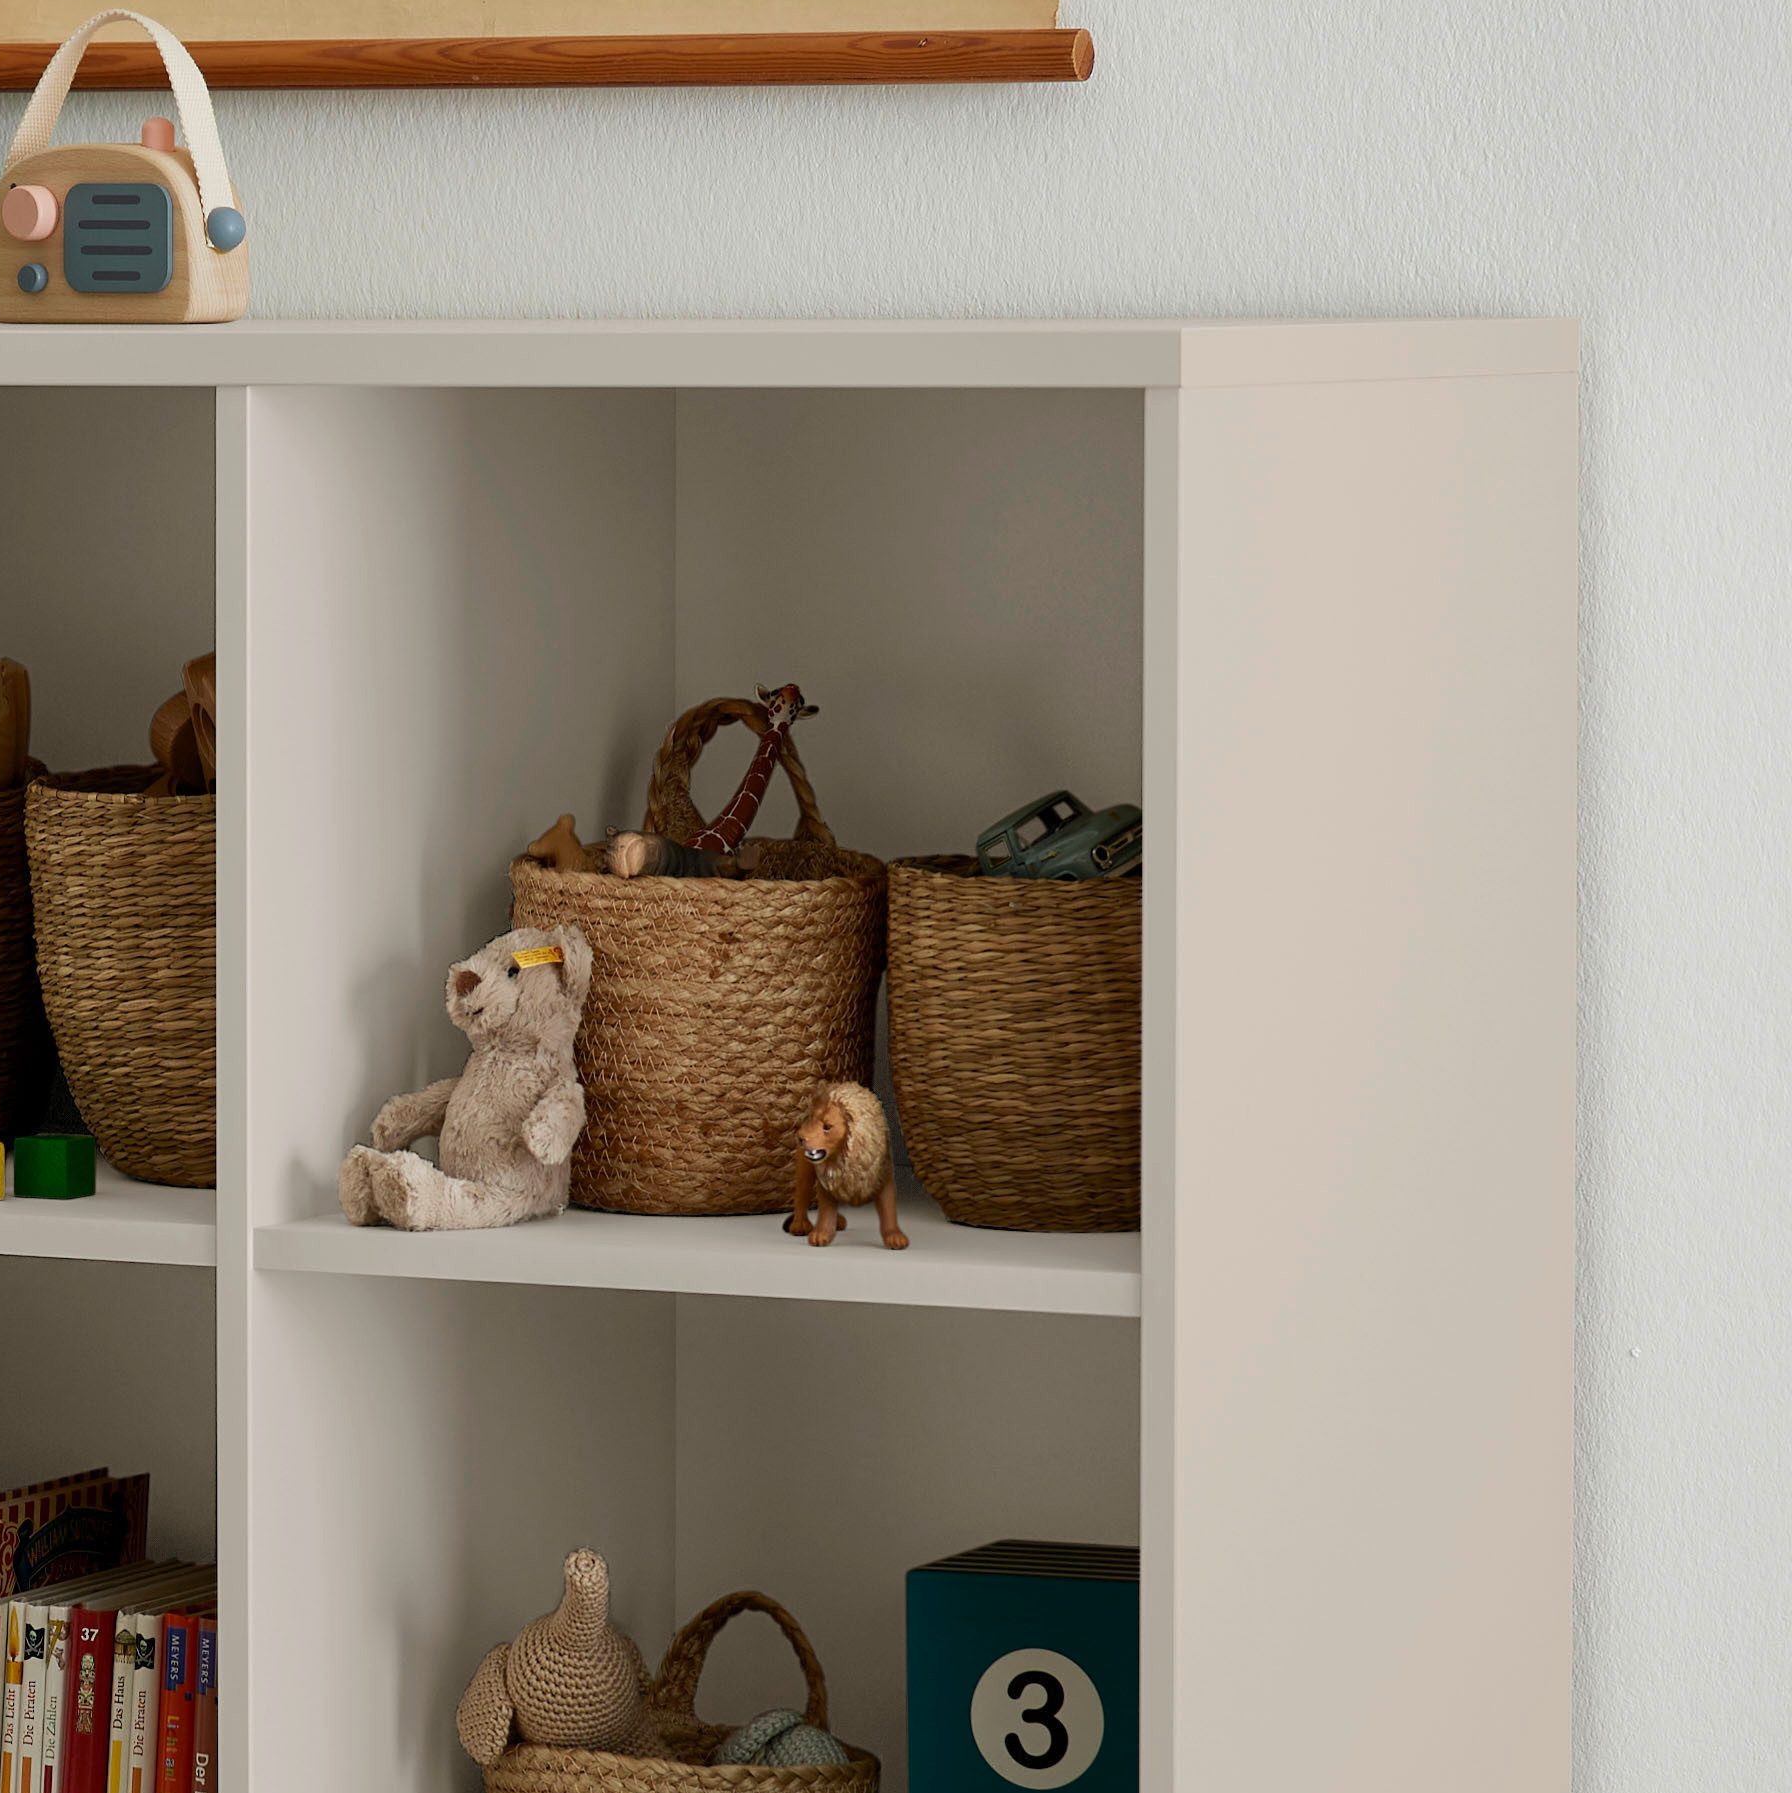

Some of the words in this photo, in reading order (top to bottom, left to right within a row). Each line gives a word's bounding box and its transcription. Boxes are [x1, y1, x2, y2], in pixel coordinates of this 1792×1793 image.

[80, 1627, 99, 1642] 37
[170, 1634, 181, 1681] MEYERS
[200, 1637, 210, 1684] MEYERS
[4, 1688, 15, 1719] Licht
[23, 1680, 36, 1720] Piraten
[113, 1675, 126, 1705] Haus
[46, 1696, 58, 1736] Zahlen
[112, 1708, 124, 1730] Das
[133, 1690, 147, 1731] Piraten
[1005, 1670, 1069, 1769] 3
[3, 1723, 14, 1745] Das
[22, 1725, 34, 1746] Die
[45, 1738, 56, 1760] Die
[132, 1735, 145, 1757] Die
[194, 1752, 209, 1786] Der
